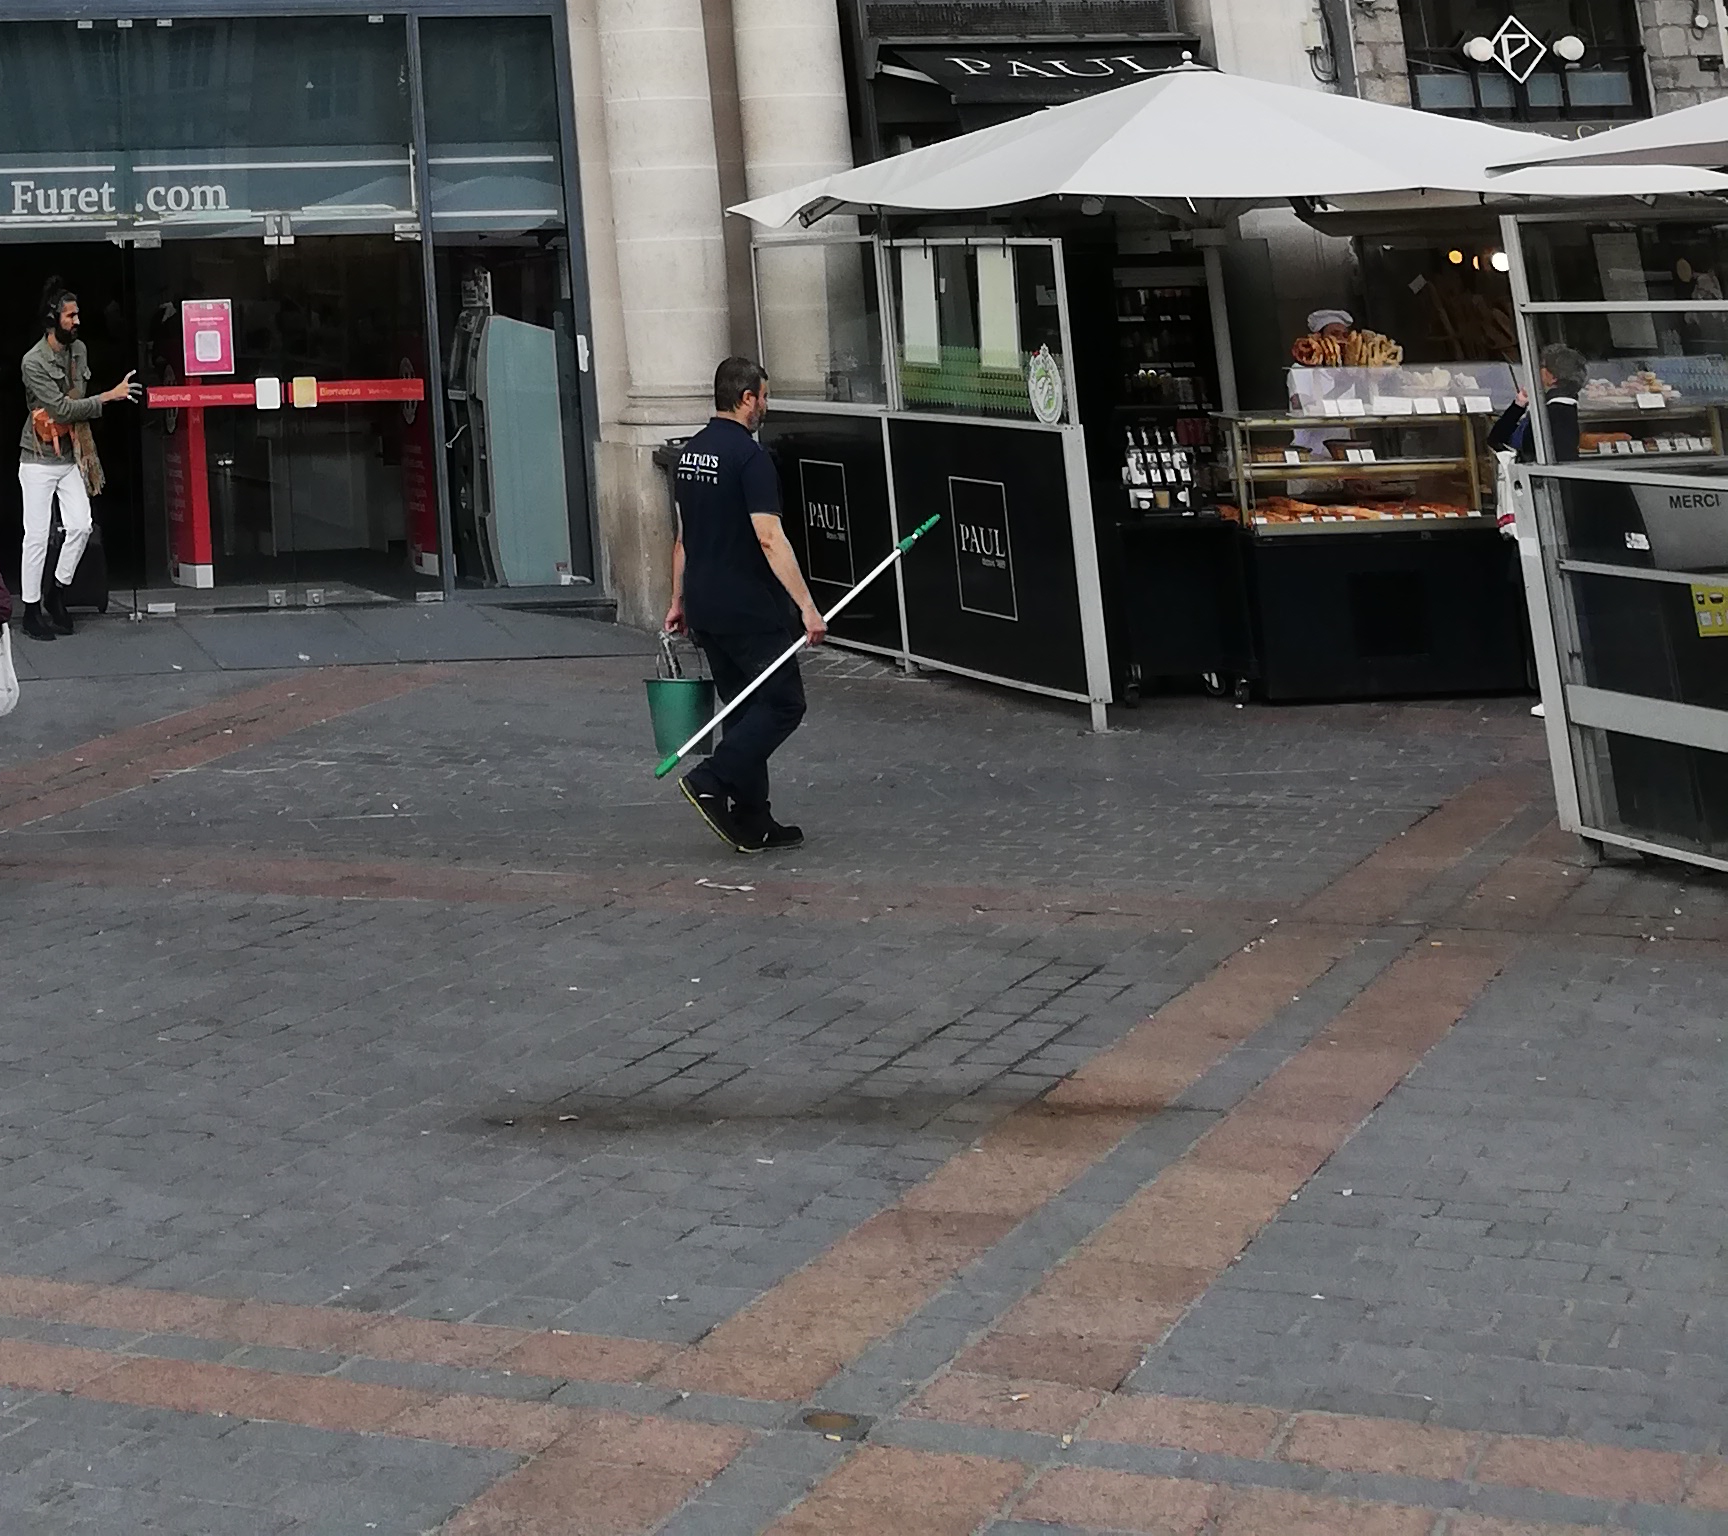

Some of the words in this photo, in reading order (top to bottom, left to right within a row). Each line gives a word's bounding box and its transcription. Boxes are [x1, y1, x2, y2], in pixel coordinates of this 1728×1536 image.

[944, 54, 1169, 79] PAUL
[10, 180, 116, 215] Furet
[134, 183, 230, 213] .com
[807, 501, 846, 532] PAUL
[1668, 493, 1721, 509] MERCI
[958, 523, 1007, 558] PAUL
